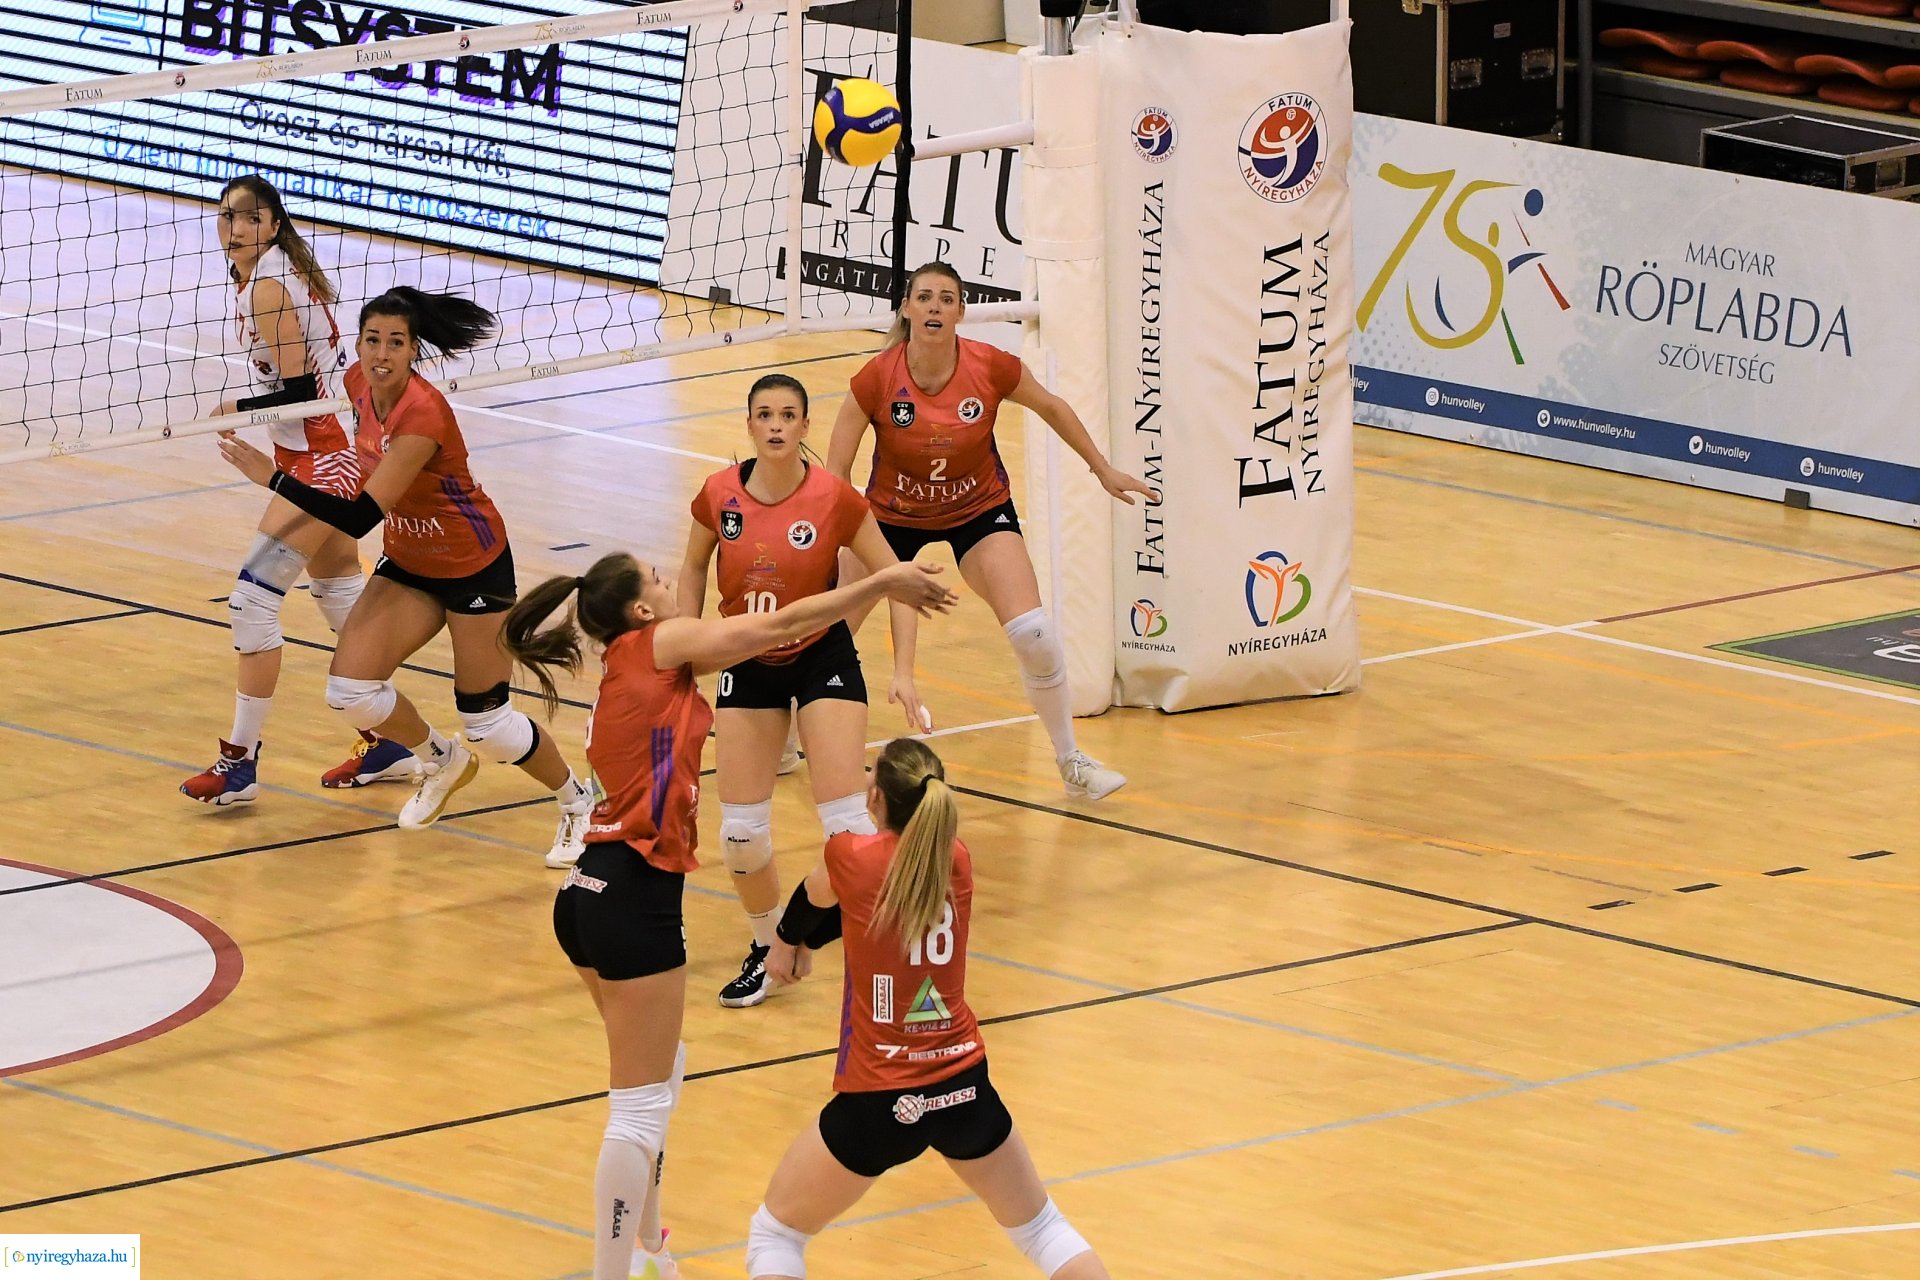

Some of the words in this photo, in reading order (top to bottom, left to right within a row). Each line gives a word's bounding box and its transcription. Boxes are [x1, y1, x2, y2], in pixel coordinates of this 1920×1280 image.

[635, 11, 672, 26] FATUM
[356, 49, 393, 64] FATUM
[65, 87, 103, 102] FATUM
[1268, 95, 1313, 112] FATUM
[240, 99, 320, 143] Orosz
[1684, 241, 1776, 278] MAGYAR
[1595, 259, 1853, 358] RÖPLABDA
[531, 365, 560, 379] FATUM
[1234, 232, 1303, 510] FATUM
[1301, 228, 1330, 497] NYÍREGYHÁZA
[1658, 342, 1776, 385] SZÖVETSÉG
[250, 412, 280, 425] FATUM
[1440, 393, 1486, 414] hunvolley
[1553, 414, 1636, 439] www.hunvolley.hu
[1705, 441, 1751, 463] hunvolley
[1818, 462, 1864, 484] hunvolley
[929, 458, 947, 481] 2
[895, 472, 977, 498] FATUM
[385, 511, 443, 533] ATUM
[1121, 640, 1176, 653] NYÍREGYHÁZA
[1227, 627, 1328, 657] NYÍREGYHÁZA
[879, 976, 888, 1020] STRABAG
